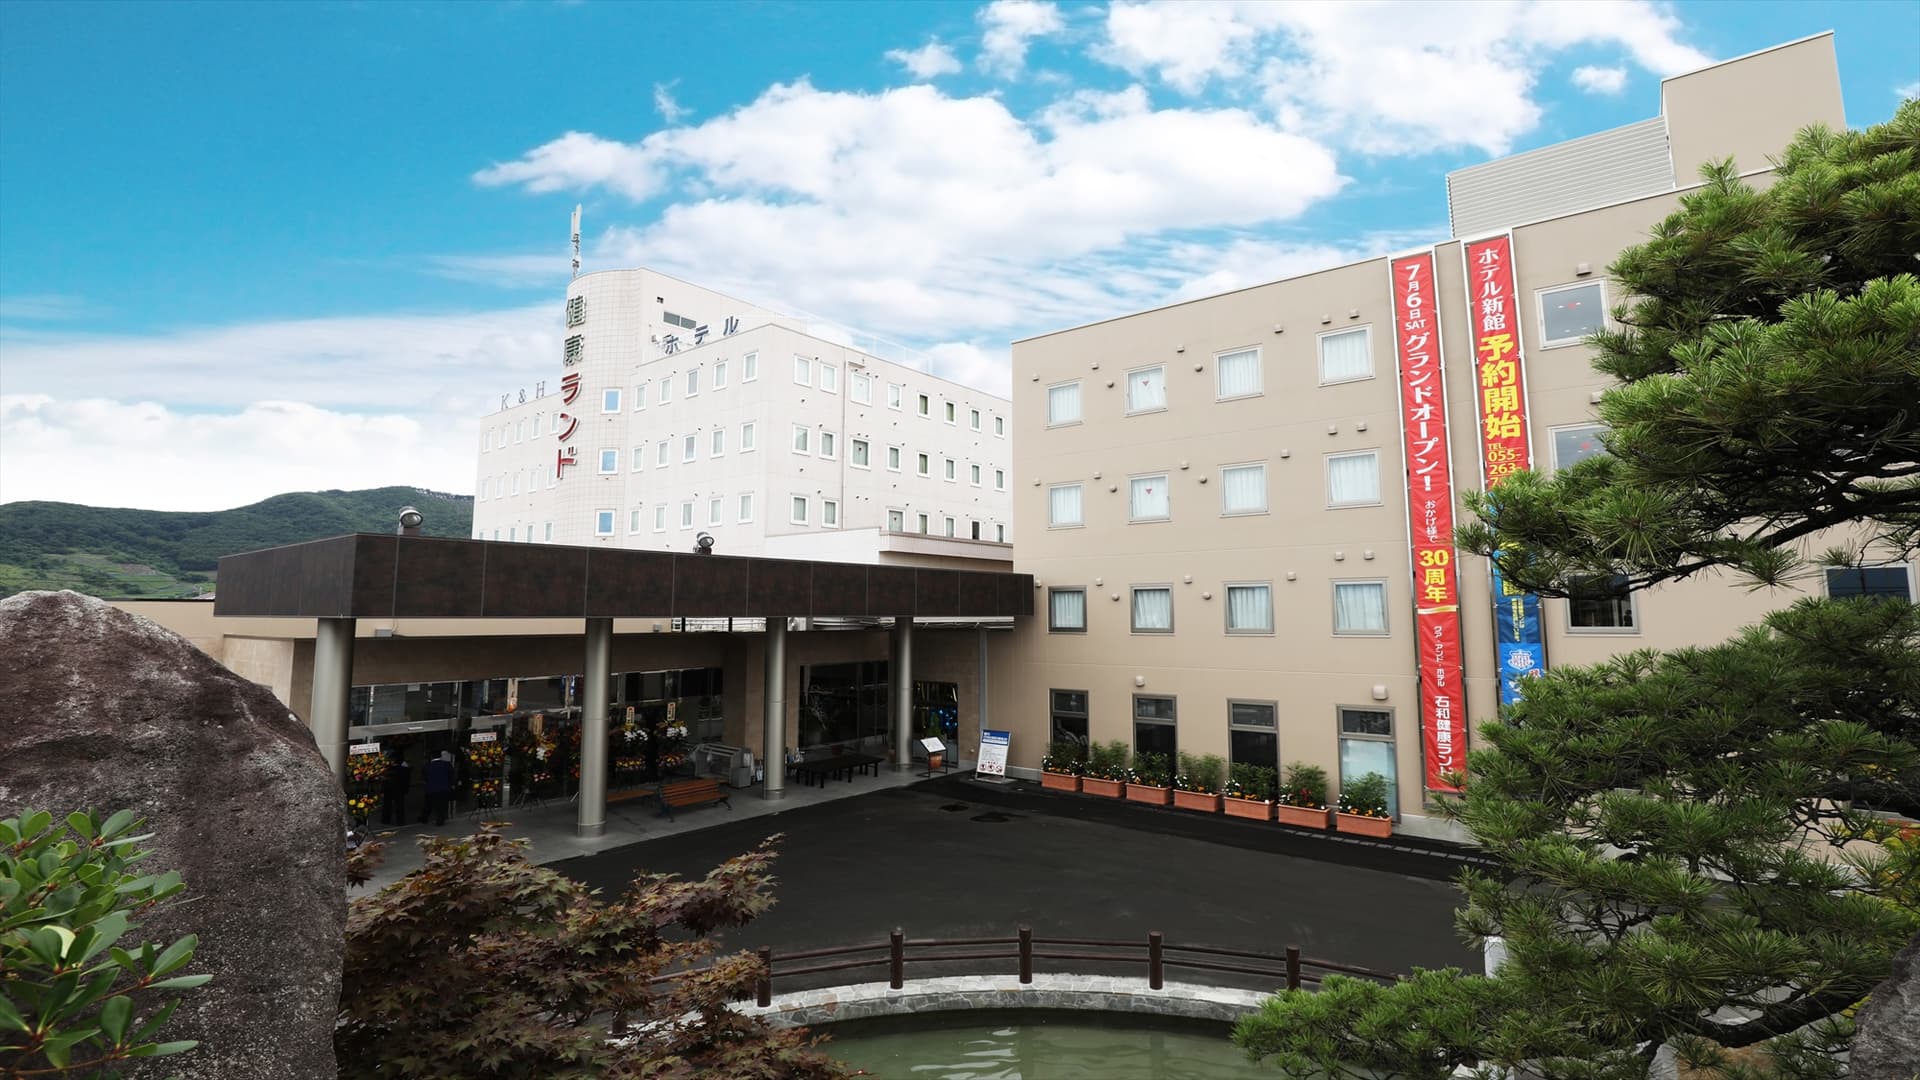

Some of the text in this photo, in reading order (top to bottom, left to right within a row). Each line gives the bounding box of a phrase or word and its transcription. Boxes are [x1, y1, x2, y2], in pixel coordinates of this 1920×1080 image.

[1479, 248, 1506, 332] ホテル新館
[663, 315, 740, 355] ホテル
[1405, 319, 1427, 331] SAT
[557, 295, 587, 480] 健康ランド
[1479, 333, 1521, 440] 予約開始
[1425, 500, 1438, 543] おかげ様で
[1419, 549, 1449, 603] 30周年
[1435, 695, 1454, 777] 石和健康ランド
